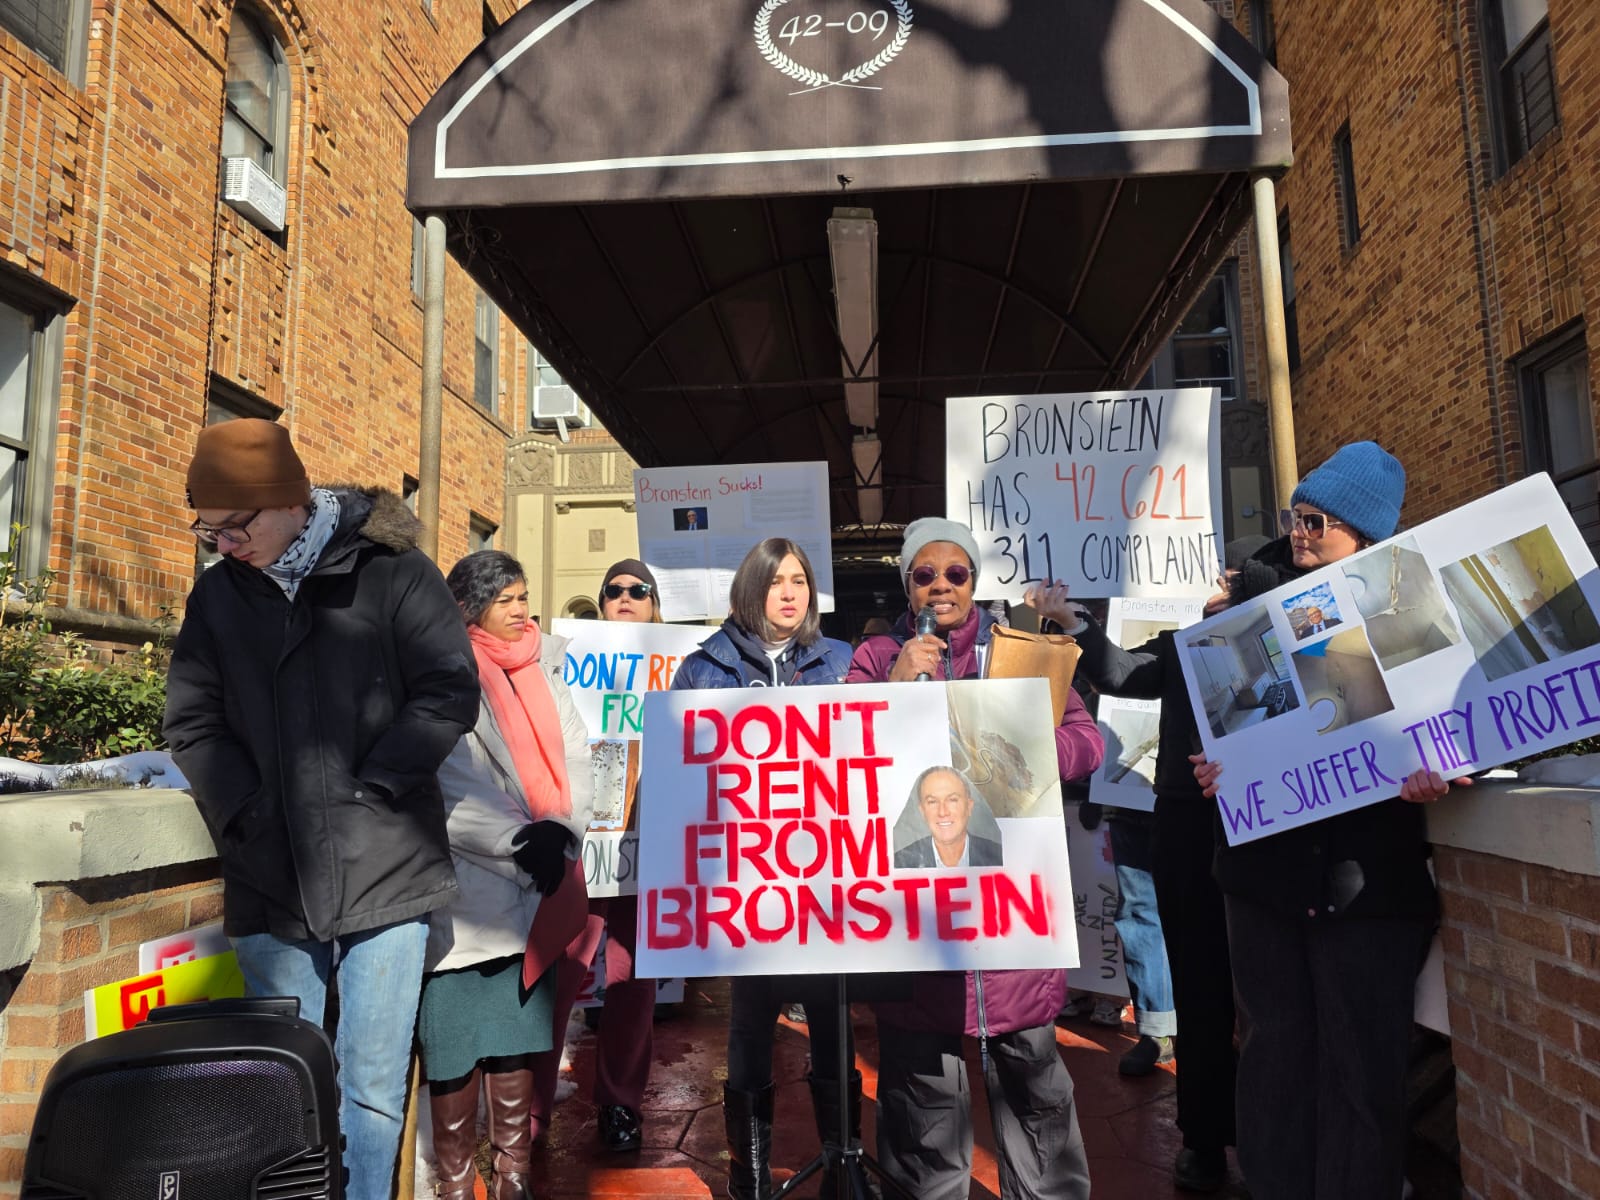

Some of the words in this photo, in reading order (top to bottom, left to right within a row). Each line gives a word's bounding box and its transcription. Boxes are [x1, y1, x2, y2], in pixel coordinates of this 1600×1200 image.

[779, 10, 889, 46] 42-09
[982, 395, 1164, 464] BRONSTEIN
[638, 477, 712, 503] Bronstein
[719, 474, 763, 495] Sucks!
[967, 472, 1031, 532] HAS
[993, 532, 1069, 587] 311
[1081, 532, 1222, 587] COMPLAINT
[563, 652, 643, 690] DON'T
[647, 653, 686, 691] RE
[602, 693, 643, 734] FR
[683, 701, 889, 765] DON'T
[706, 757, 893, 821] RENT
[1219, 779, 1275, 835] WE
[1402, 701, 1479, 778] THEY
[583, 838, 639, 885] ONST
[684, 817, 889, 885] FROM
[646, 873, 1050, 950] BRONSTEIN
